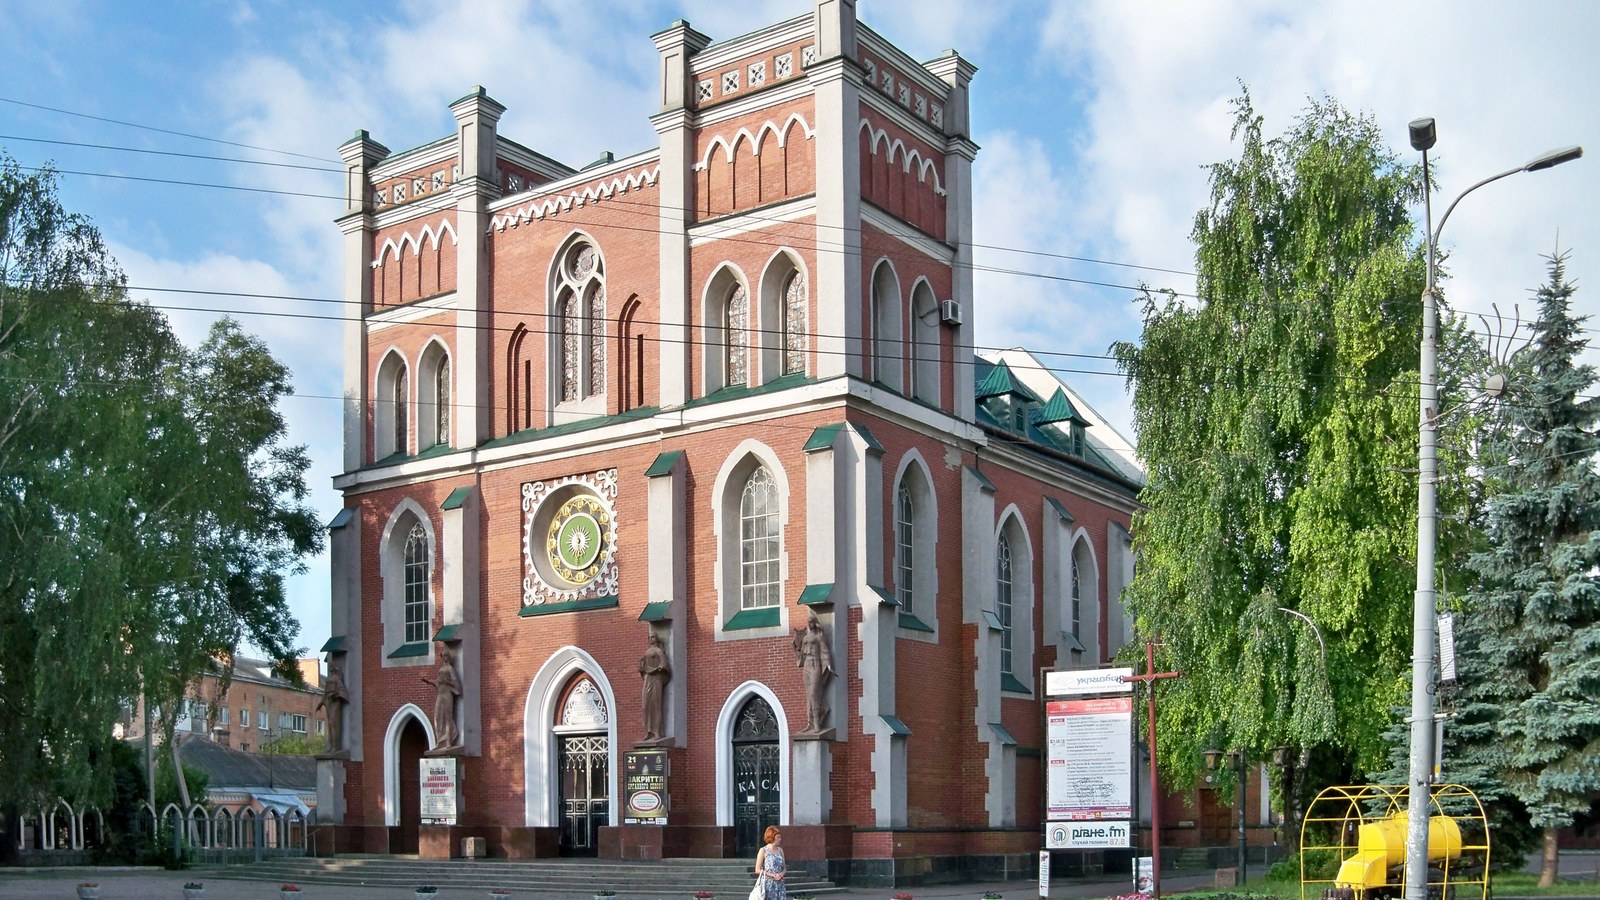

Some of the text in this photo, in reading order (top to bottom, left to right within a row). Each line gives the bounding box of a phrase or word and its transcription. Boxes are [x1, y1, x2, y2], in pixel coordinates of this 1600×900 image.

[628, 775, 664, 783] ЗАКРИТТЯ
[738, 779, 780, 793] КАСА
[1072, 826, 1126, 840] рівне.fm
[1109, 838, 1125, 846] 87.8
